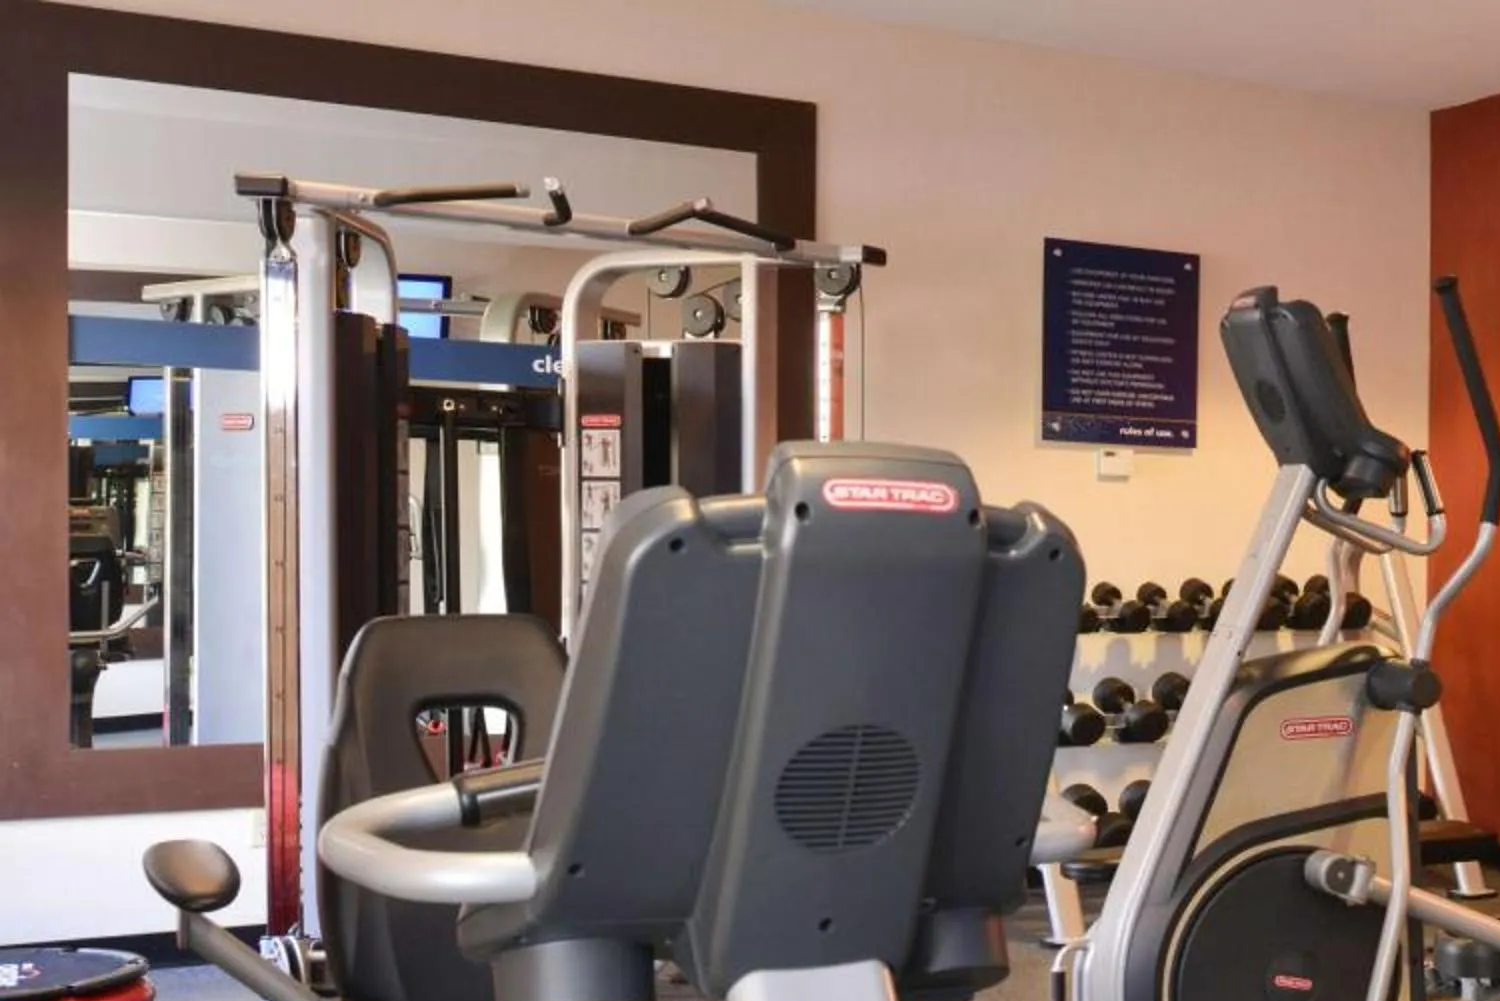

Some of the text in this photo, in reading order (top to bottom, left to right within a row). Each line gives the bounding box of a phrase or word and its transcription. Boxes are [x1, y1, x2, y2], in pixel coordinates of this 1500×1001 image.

[1144, 427, 1155, 437] of
[832, 485, 945, 504] STAR TRAC
